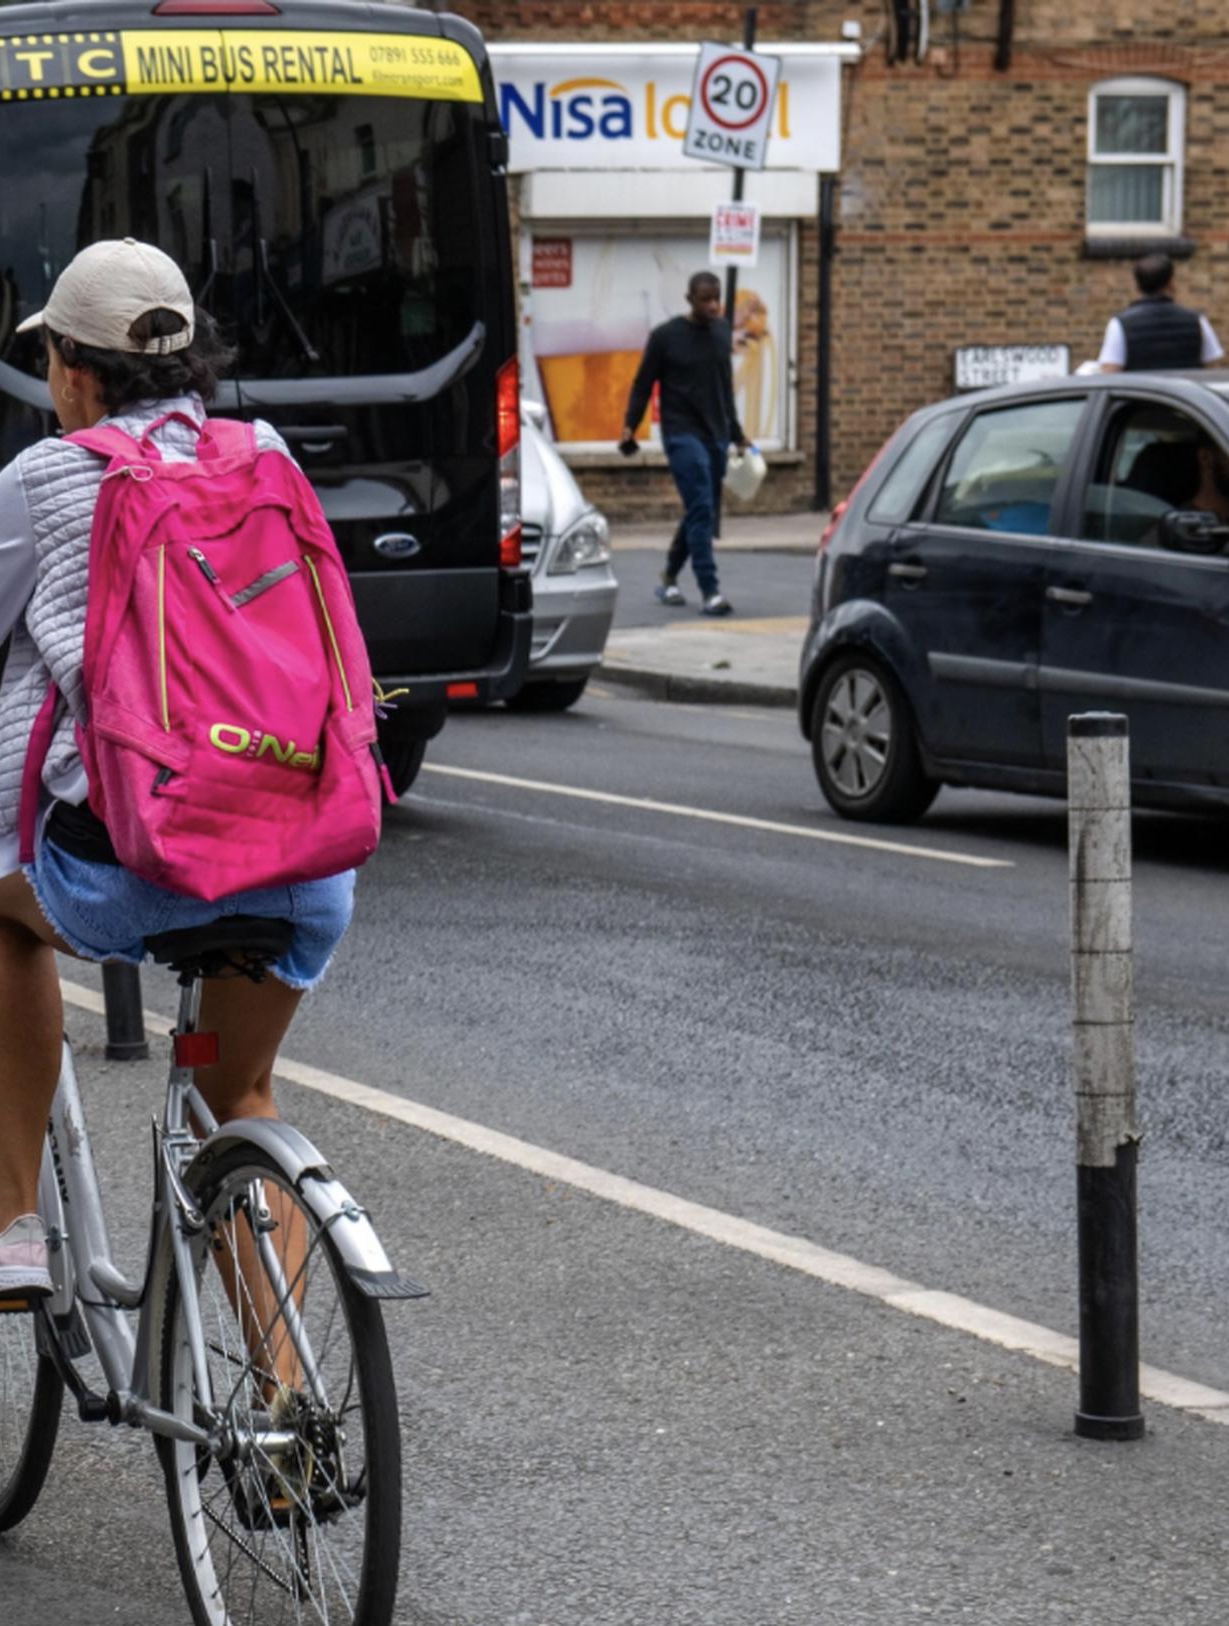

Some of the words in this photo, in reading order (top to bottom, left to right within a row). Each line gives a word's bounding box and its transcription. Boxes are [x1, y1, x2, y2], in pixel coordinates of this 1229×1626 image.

[137, 46, 194, 84] MINI
[201, 46, 255, 84] BUS
[263, 47, 363, 84] RENTAL
[370, 46, 407, 64] 07891
[411, 48, 435, 65] 555
[437, 50, 461, 66] 666
[710, 75, 758, 110] 20
[500, 80, 633, 139] Nisa
[645, 81, 792, 139] lol
[693, 129, 757, 160] ZONE
[959, 347, 1059, 364] EARLSWOOD
[960, 366, 1021, 386] STREET
